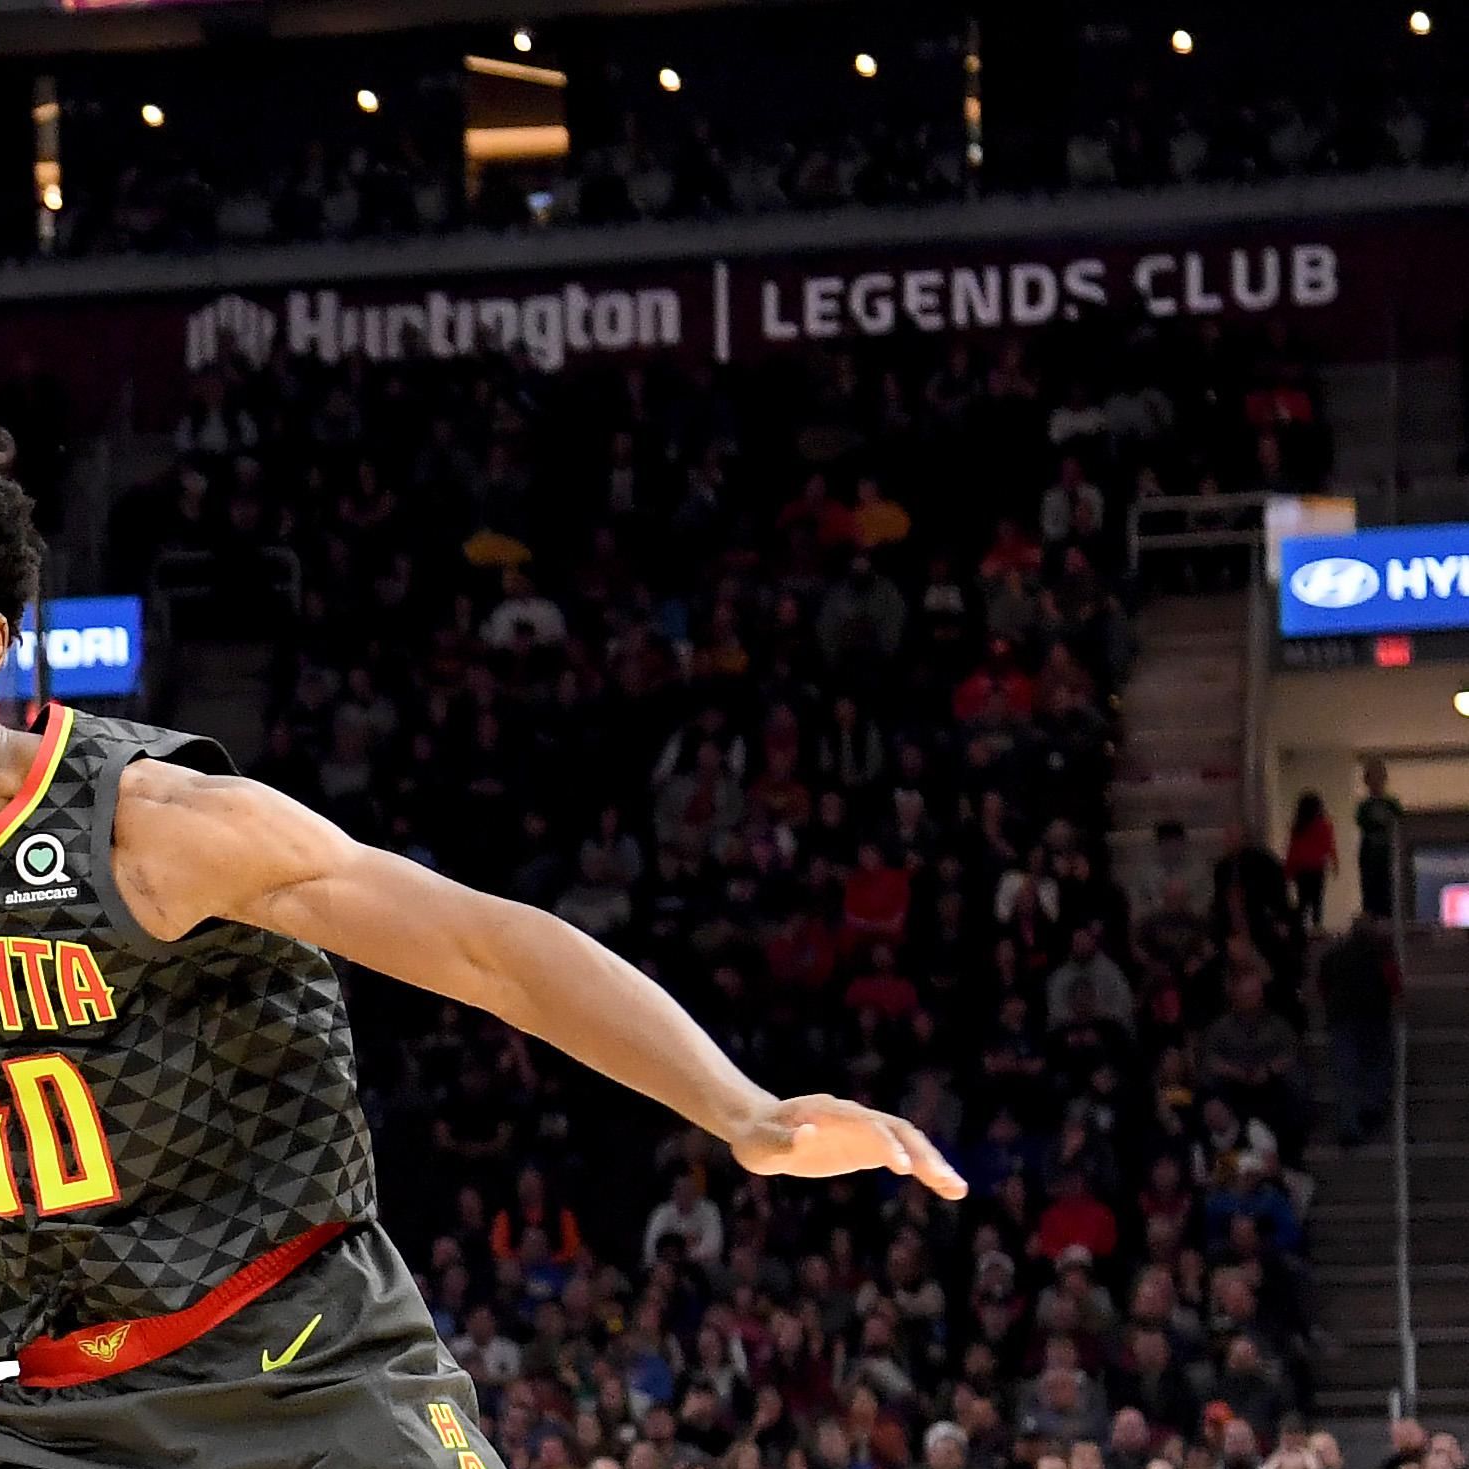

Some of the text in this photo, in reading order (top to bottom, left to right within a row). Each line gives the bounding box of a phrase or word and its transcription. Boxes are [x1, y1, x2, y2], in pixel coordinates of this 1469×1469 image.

[760, 262, 1105, 342] LEGENDS
[1133, 243, 1338, 318] CLUB
[5, 885, 78, 905] sharecare
